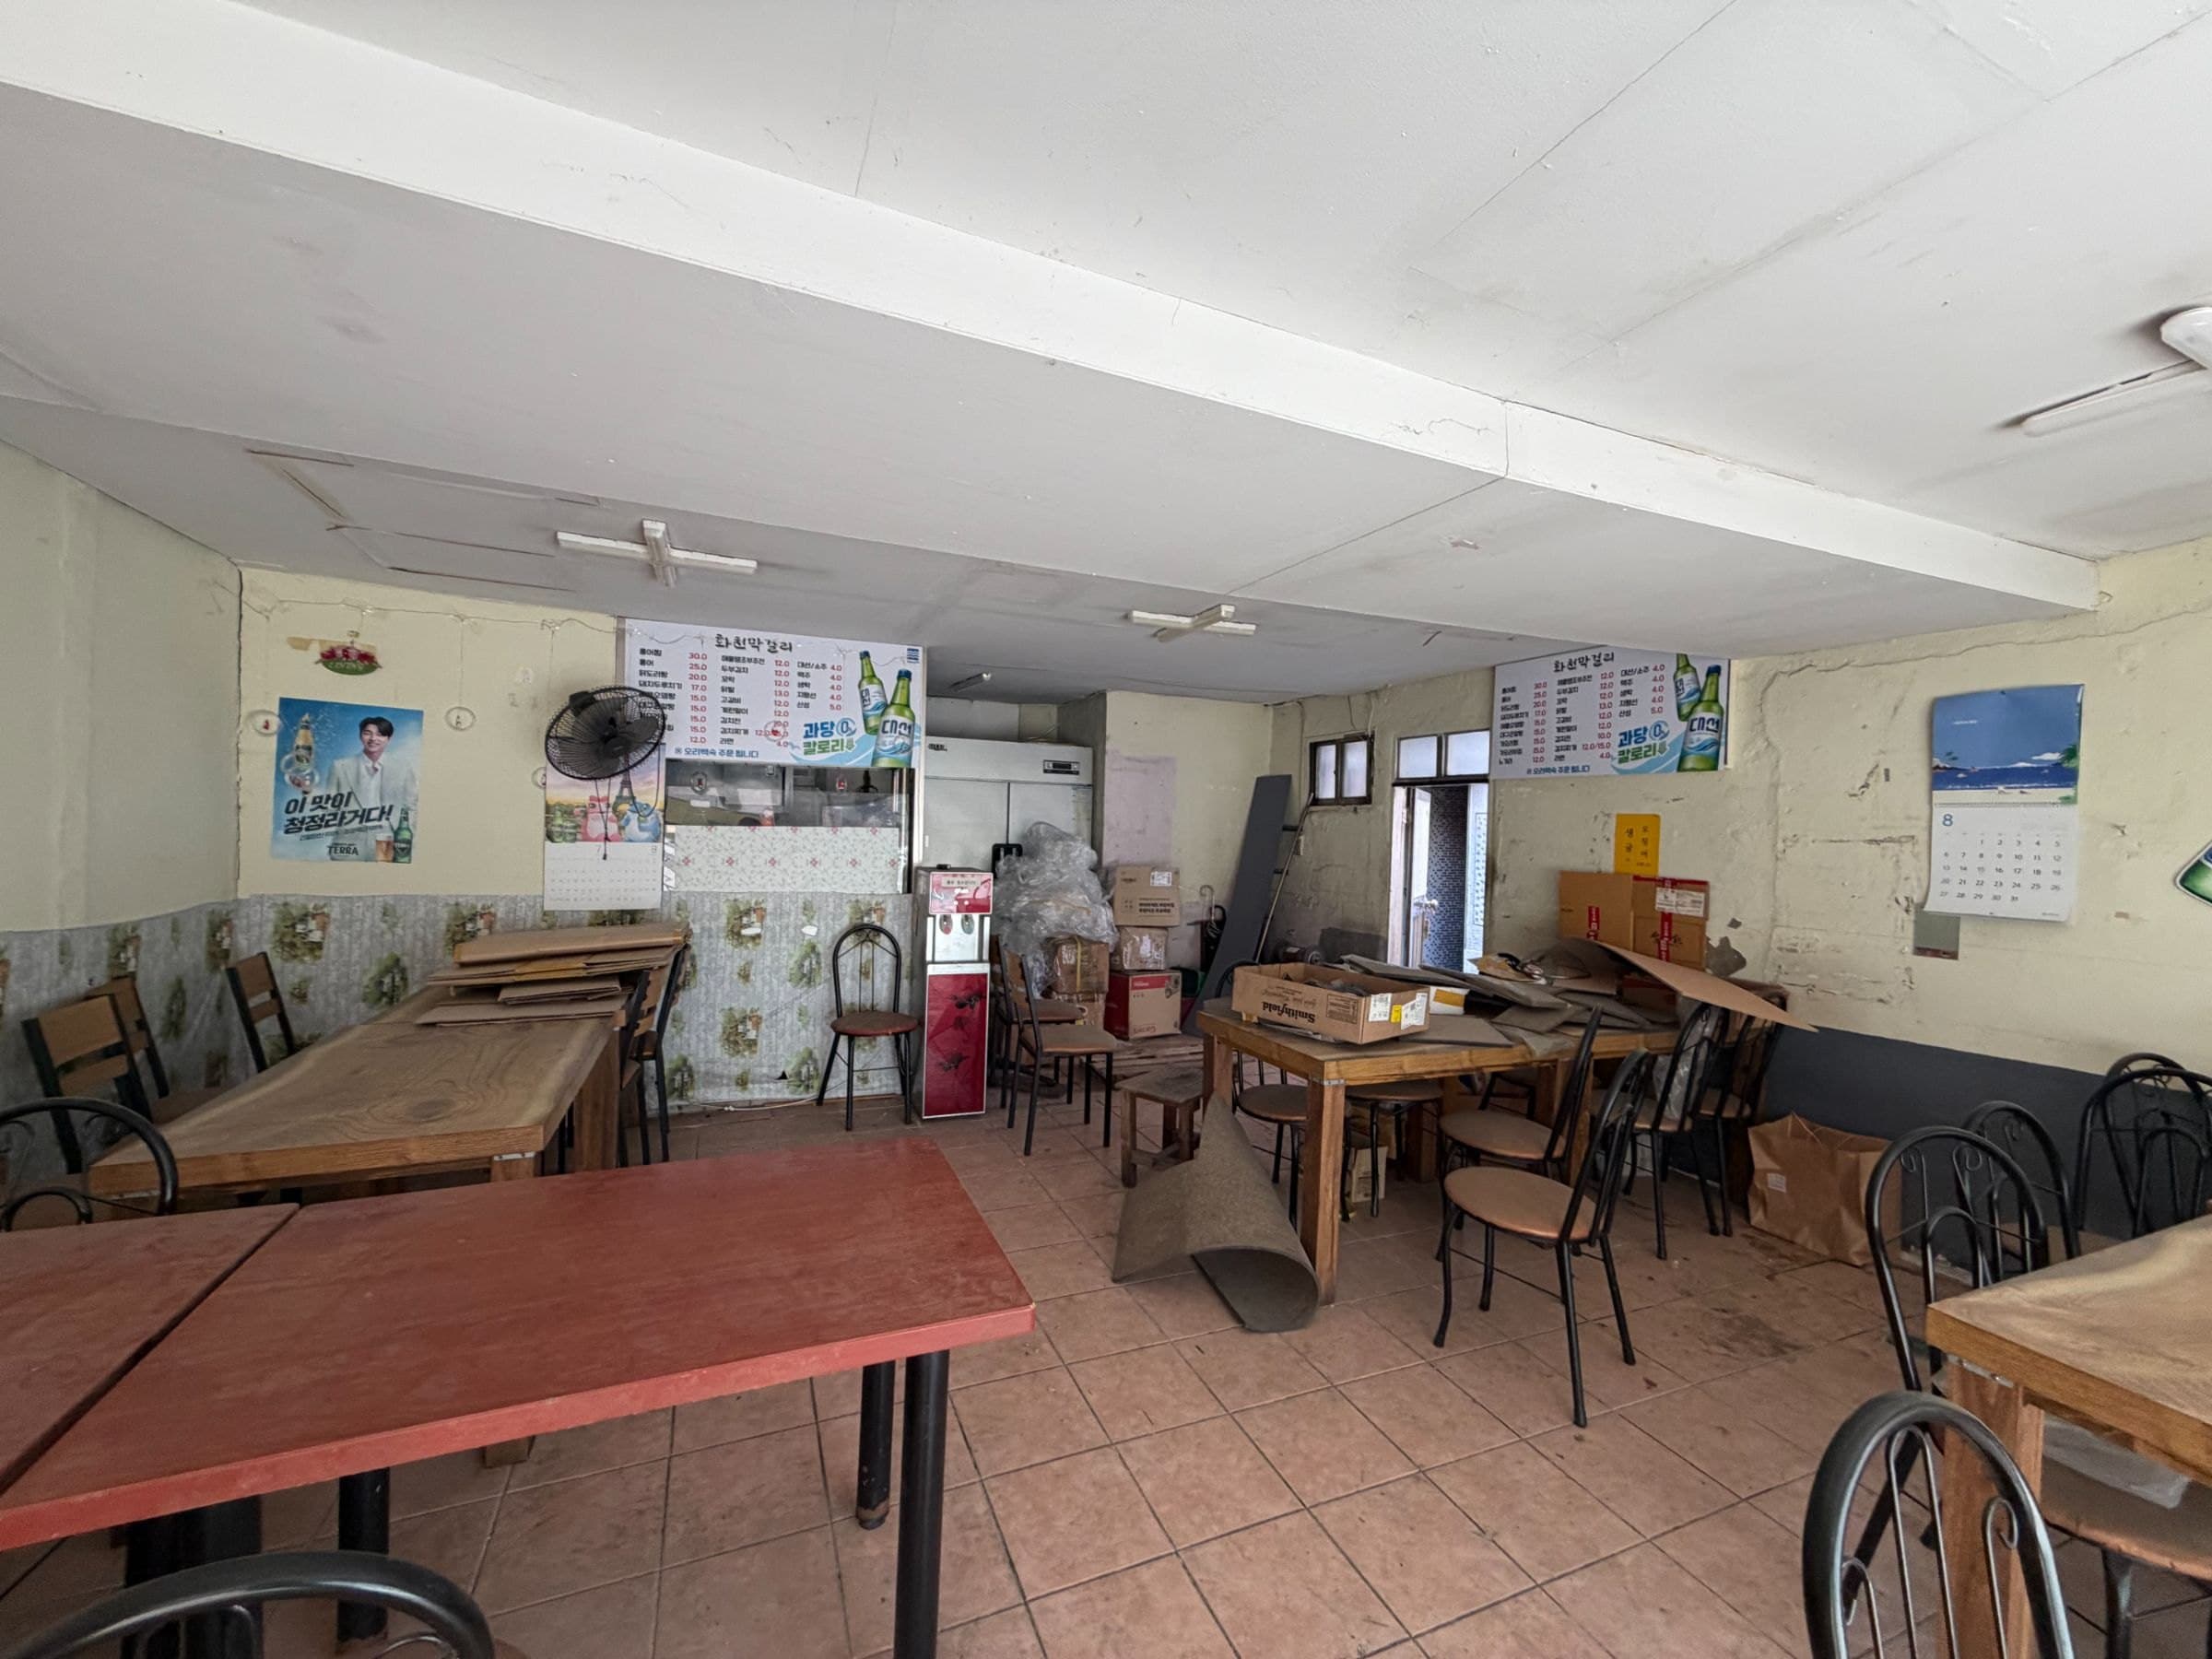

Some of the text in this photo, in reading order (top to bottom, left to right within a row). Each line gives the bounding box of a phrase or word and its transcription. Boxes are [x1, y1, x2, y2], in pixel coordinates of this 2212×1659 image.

[688, 653, 707, 661] 30.0
[688, 663, 707, 671] 25.0
[1554, 652, 1615, 673] 화천막걸리
[1652, 664, 1665, 672] 4.0
[688, 673, 707, 682] 20.0
[1600, 671, 1615, 680] 12.0
[691, 684, 706, 692] 17.0
[690, 694, 706, 702] 15.0
[1600, 691, 1613, 700] 12.0
[1652, 696, 1664, 704] 4.0
[1599, 701, 1613, 710] 13.0
[1652, 706, 1663, 714] 5.0
[804, 720, 835, 739] 과당
[881, 719, 912, 735] 대선
[1688, 717, 1720, 734] 대선
[1618, 726, 1649, 748] 과당
[803, 738, 844, 756] 칼로리
[1582, 741, 1611, 751] 12.0/15.0
[1618, 744, 1657, 765] 칼로리
[284, 791, 354, 815] 이 맛이
[284, 804, 394, 835] 청정라거다!
[1942, 813, 1953, 827] 8
[328, 846, 359, 855] TERRA
[1263, 1001, 1316, 1024] Smithfield
